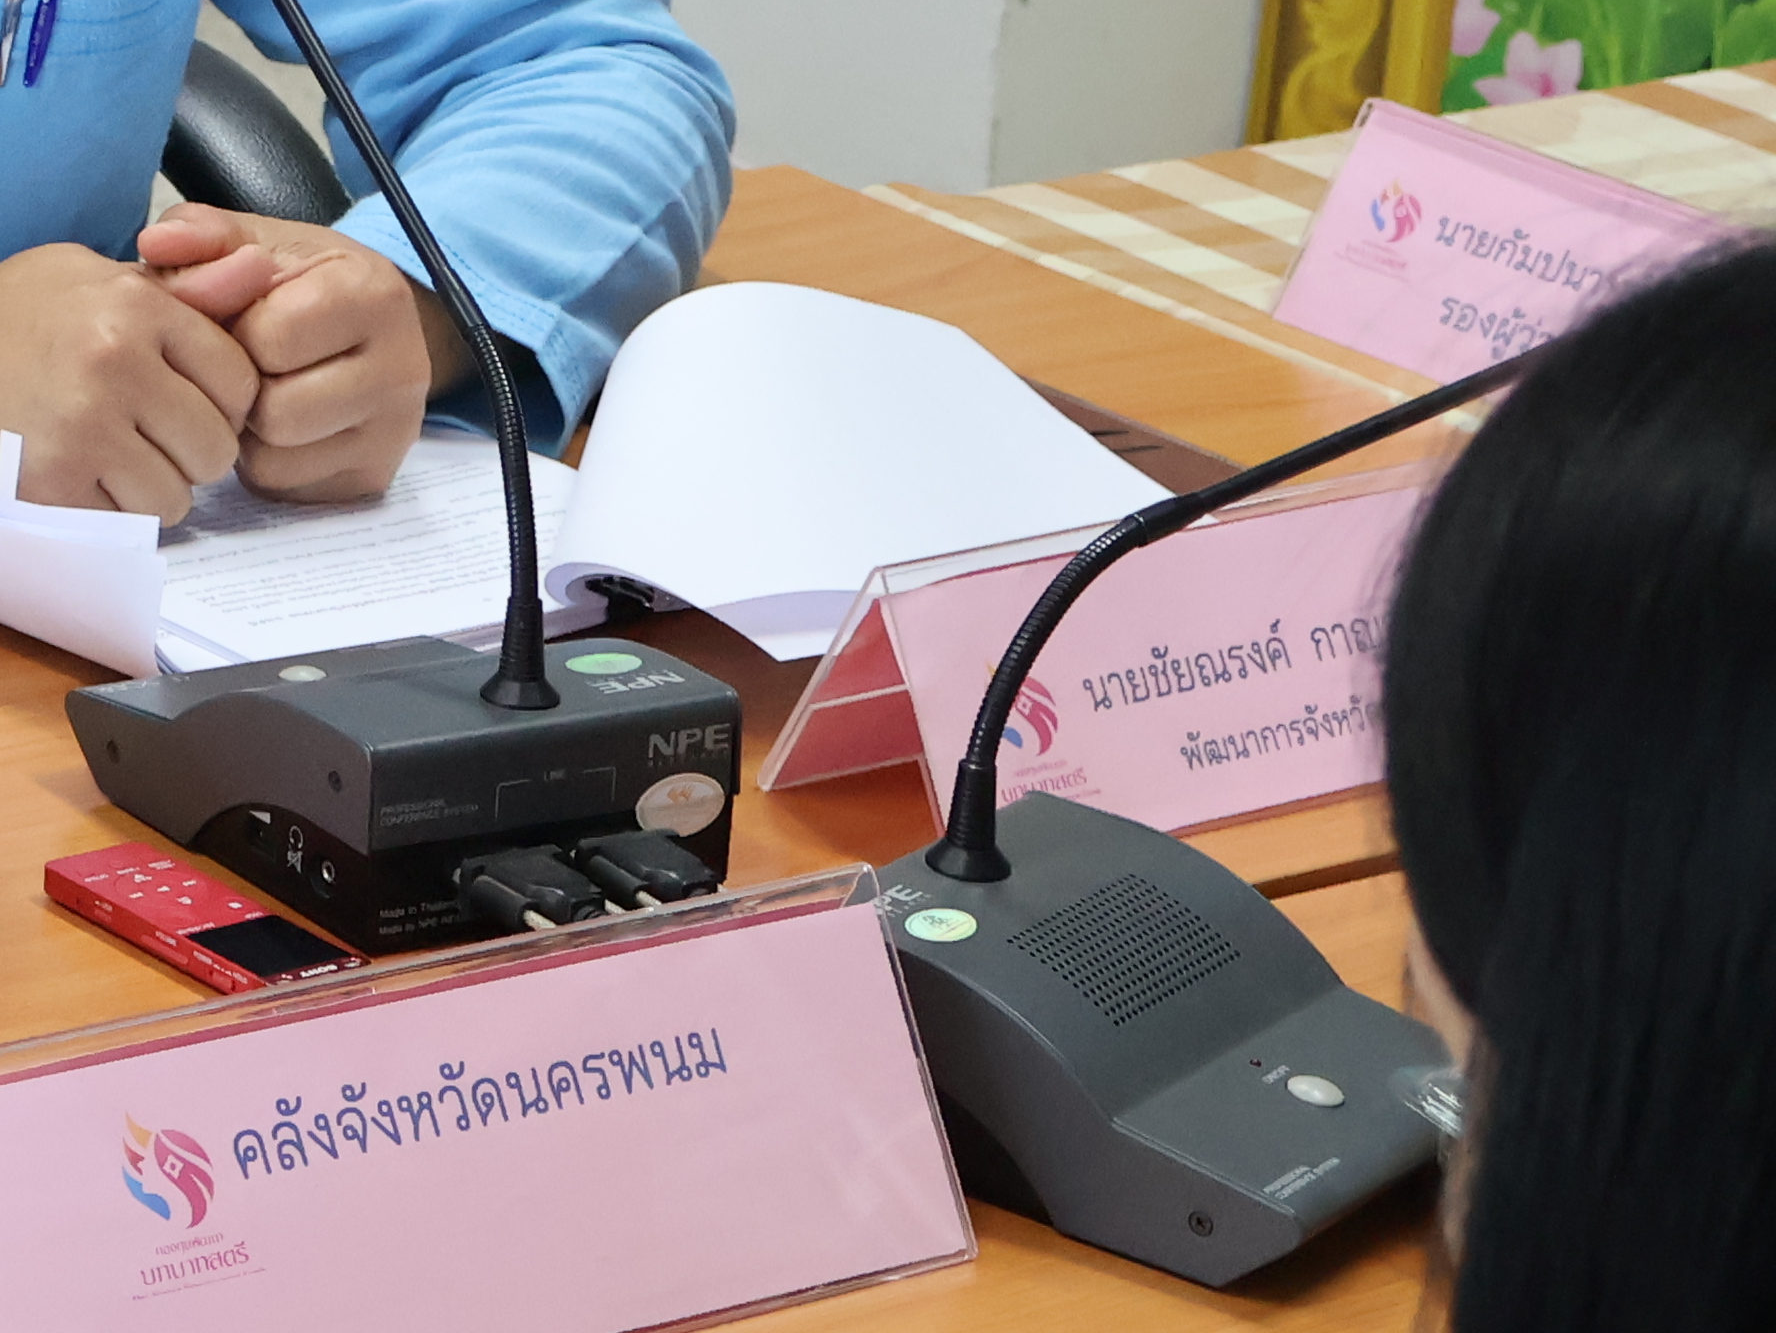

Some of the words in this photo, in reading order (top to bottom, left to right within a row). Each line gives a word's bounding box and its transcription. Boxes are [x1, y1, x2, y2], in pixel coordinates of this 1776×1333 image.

[1435, 215, 1604, 293] นายกัมปนา
[591, 669, 686, 695] NPE
[1081, 618, 1292, 712] นายชัยณรงค์
[647, 723, 731, 759] NPE
[230, 1024, 729, 1180] คลังจังหวัดนครพนม
[139, 1240, 251, 1286] บทบาทสตรี
